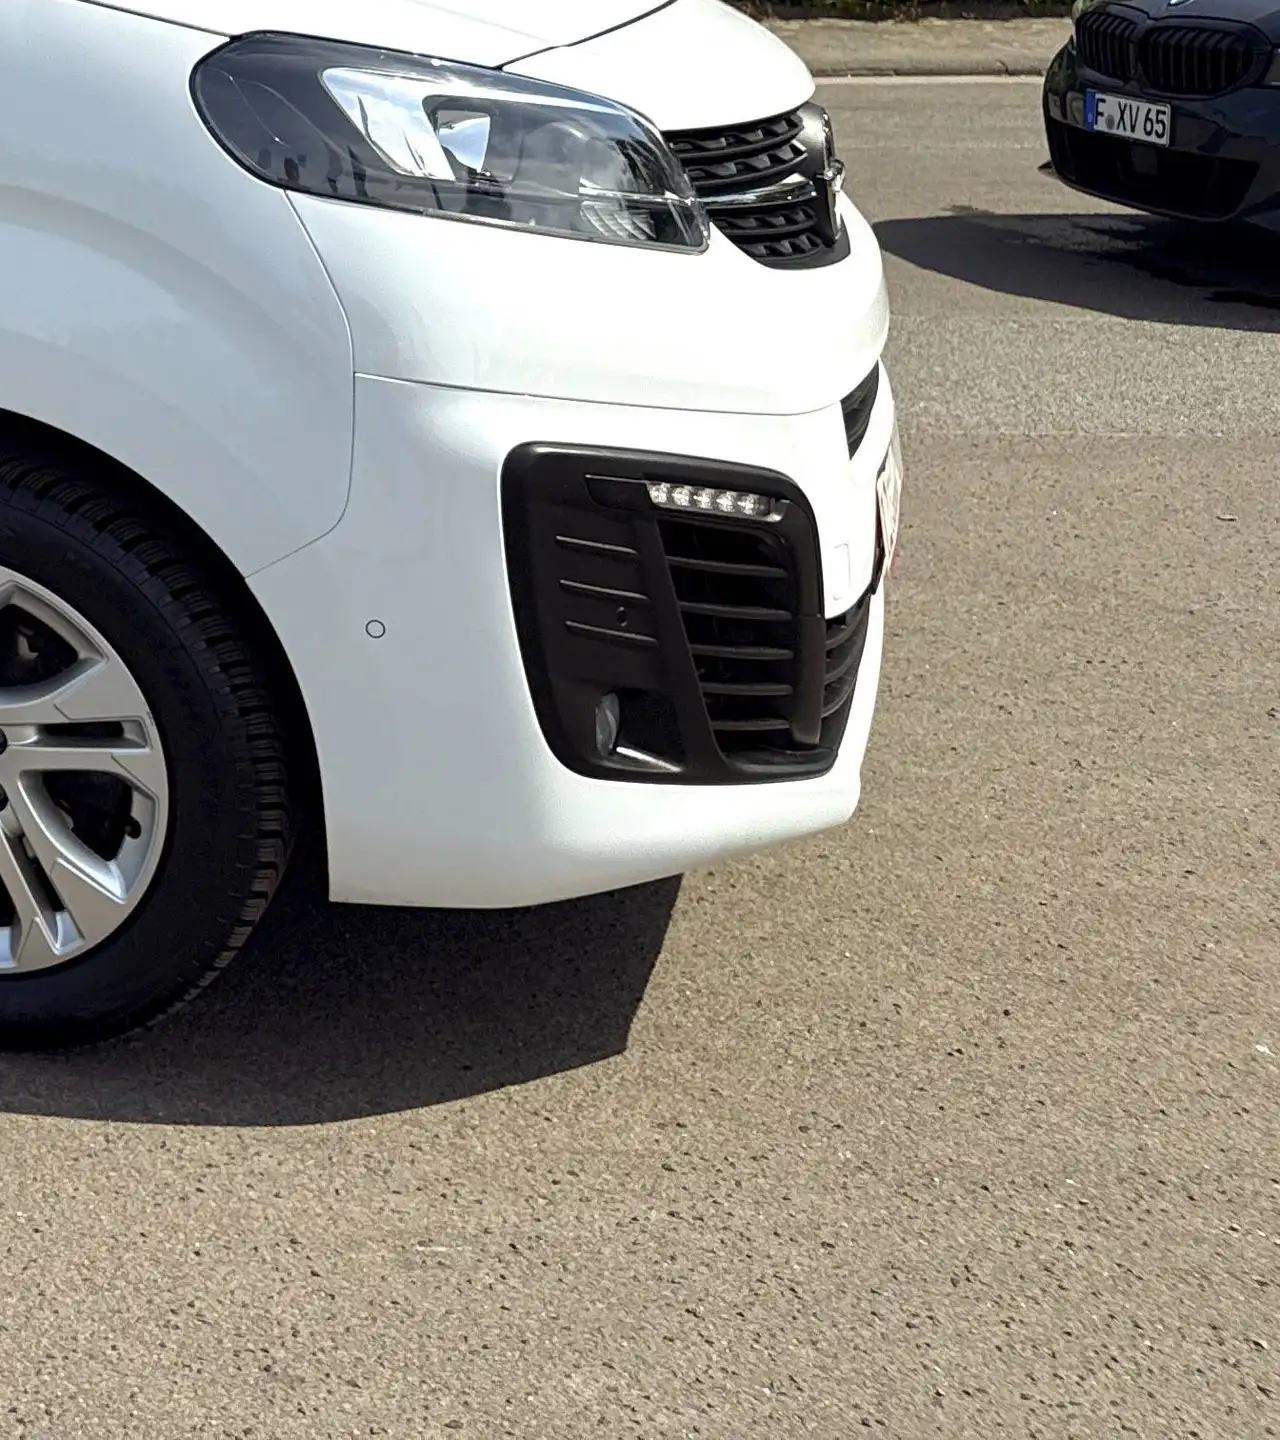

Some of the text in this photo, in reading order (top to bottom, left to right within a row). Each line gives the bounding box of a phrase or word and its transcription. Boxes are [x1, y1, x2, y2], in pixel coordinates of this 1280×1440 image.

[1094, 98, 1167, 138] F XV 65
